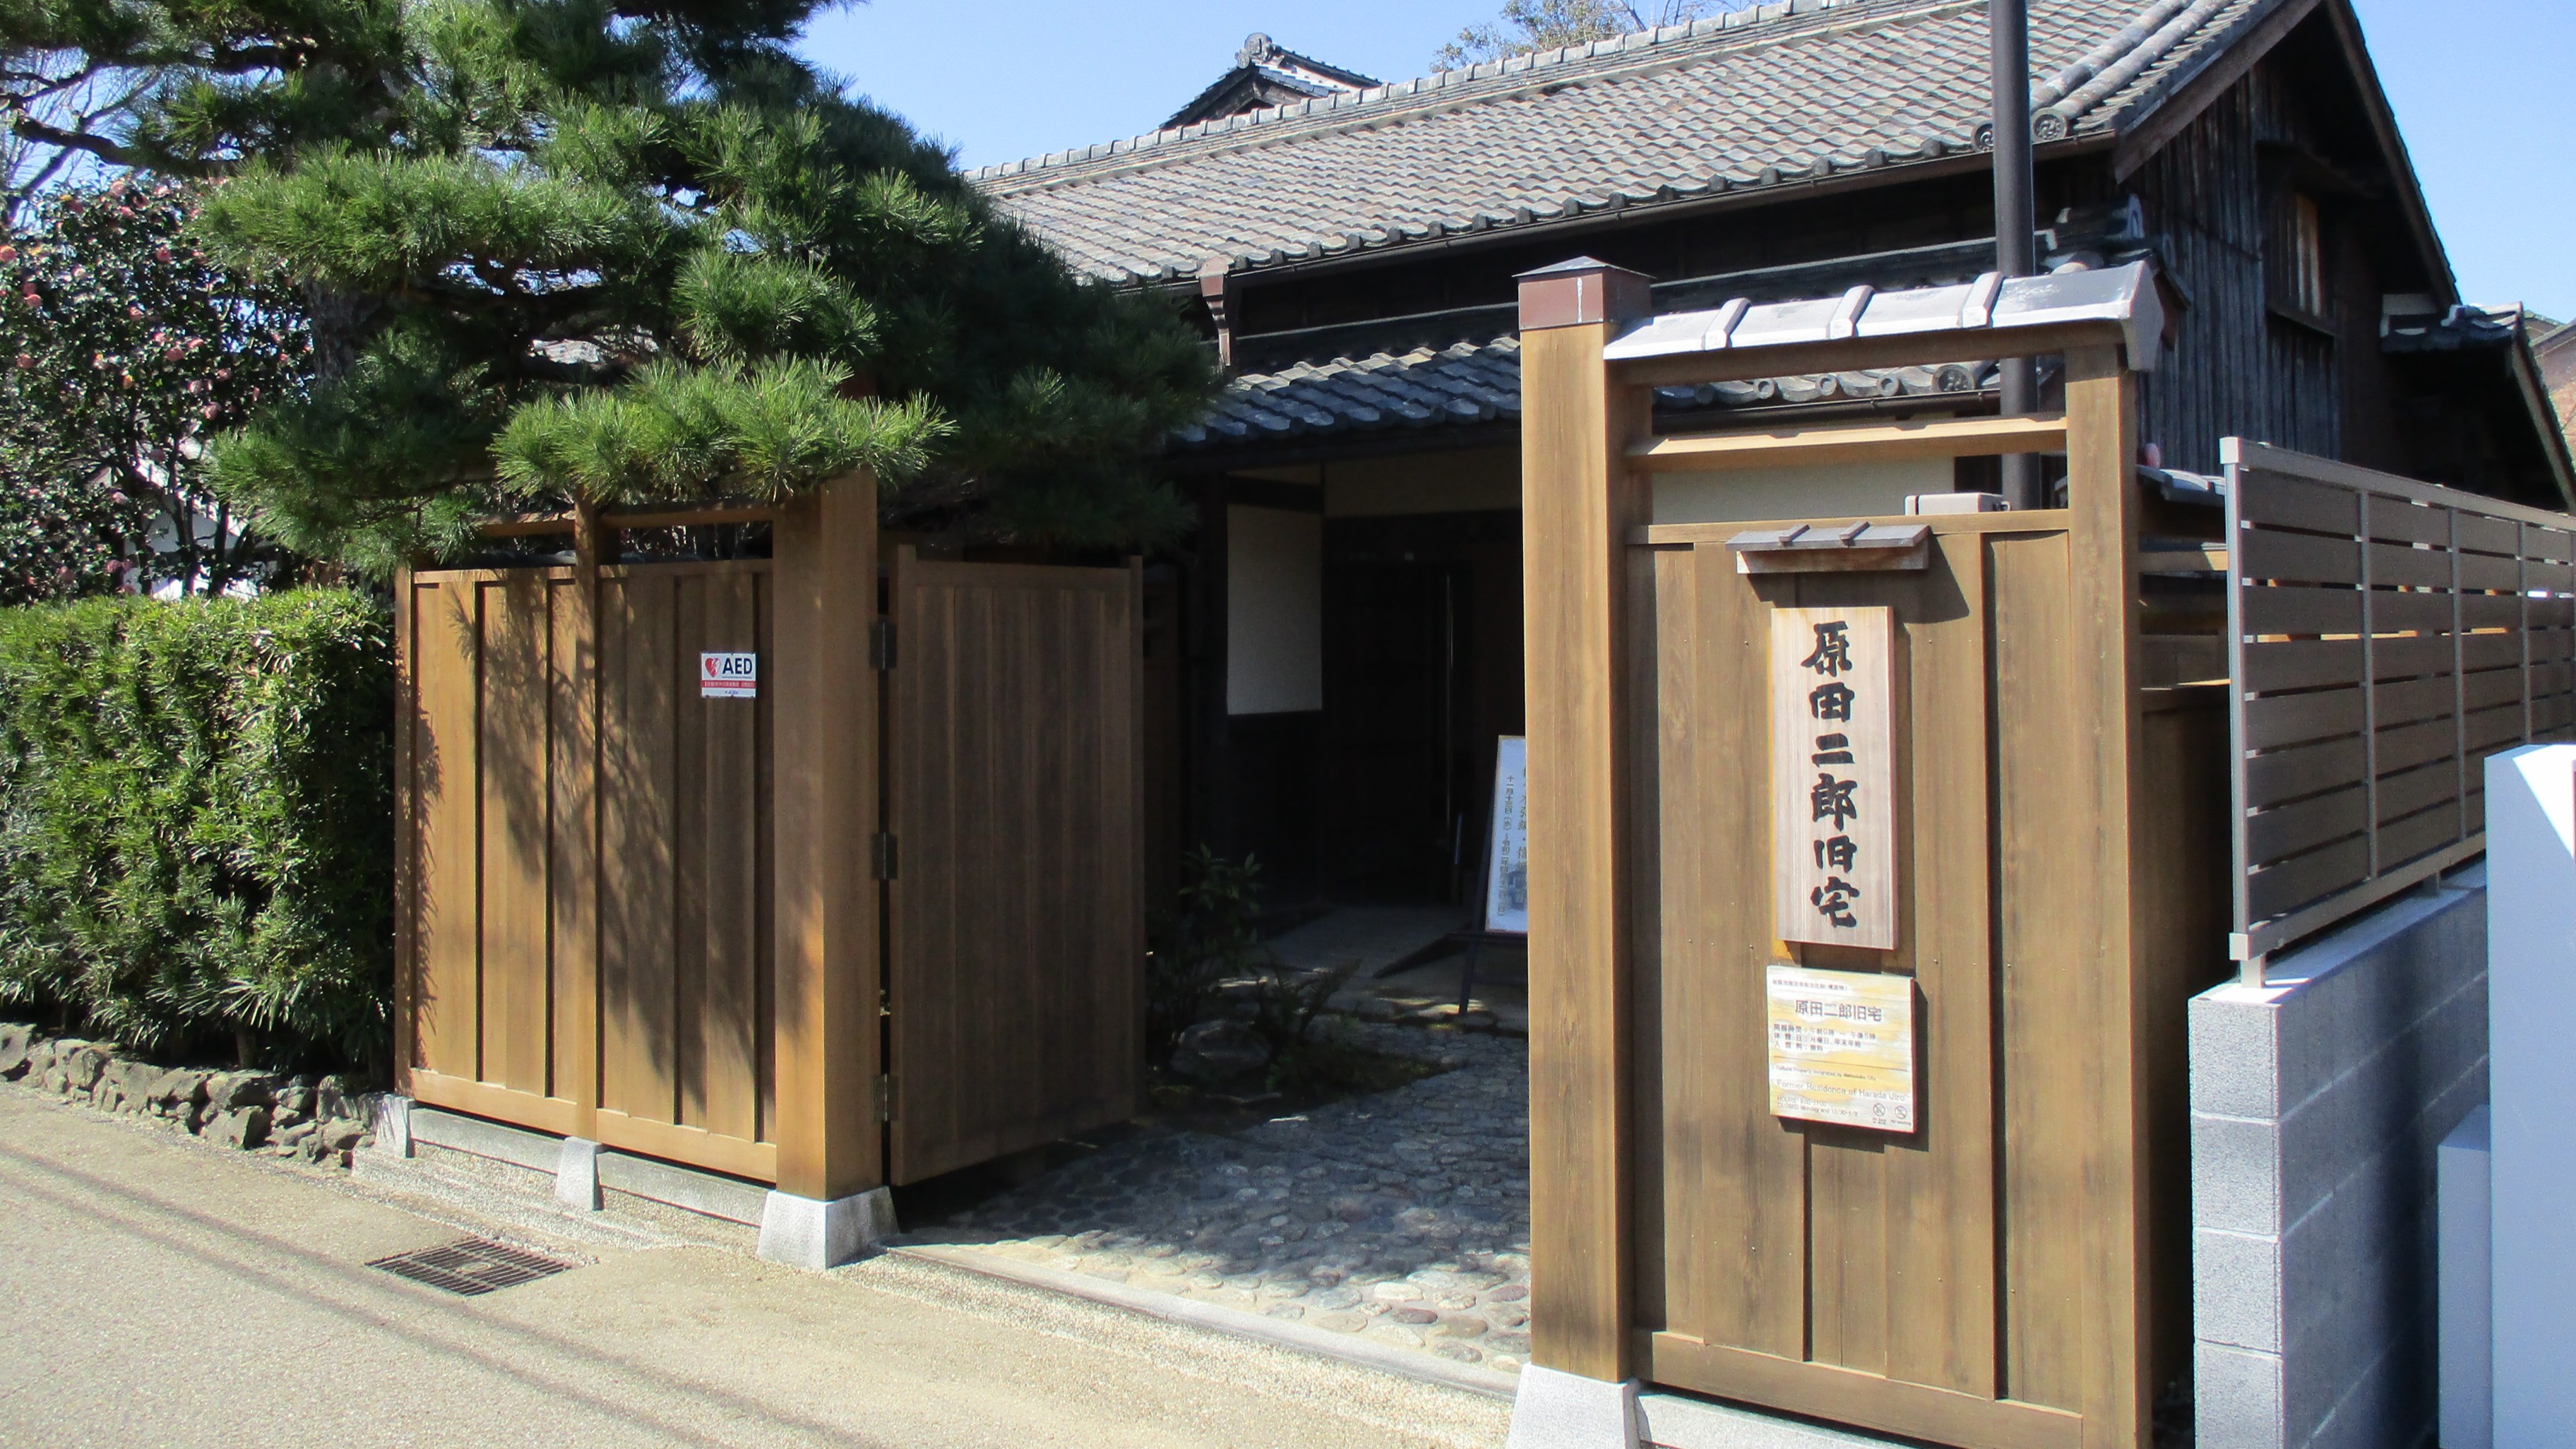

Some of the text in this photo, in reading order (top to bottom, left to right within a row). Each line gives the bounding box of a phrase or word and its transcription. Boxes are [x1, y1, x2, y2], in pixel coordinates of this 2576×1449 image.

[722, 657, 753, 674] AED
[1801, 621, 1860, 929] 原田二郎旧宅
[1795, 998, 1883, 1022] 原田二郎旧宅
[1777, 1079, 1803, 1090] Former
[1806, 1083, 1847, 1095] Residence
[1859, 1088, 1887, 1099] Harada
[1890, 1092, 1905, 1102] Jiro
[1777, 1102, 1799, 1110] CLOSED
[1800, 1104, 1820, 1114] Monday
